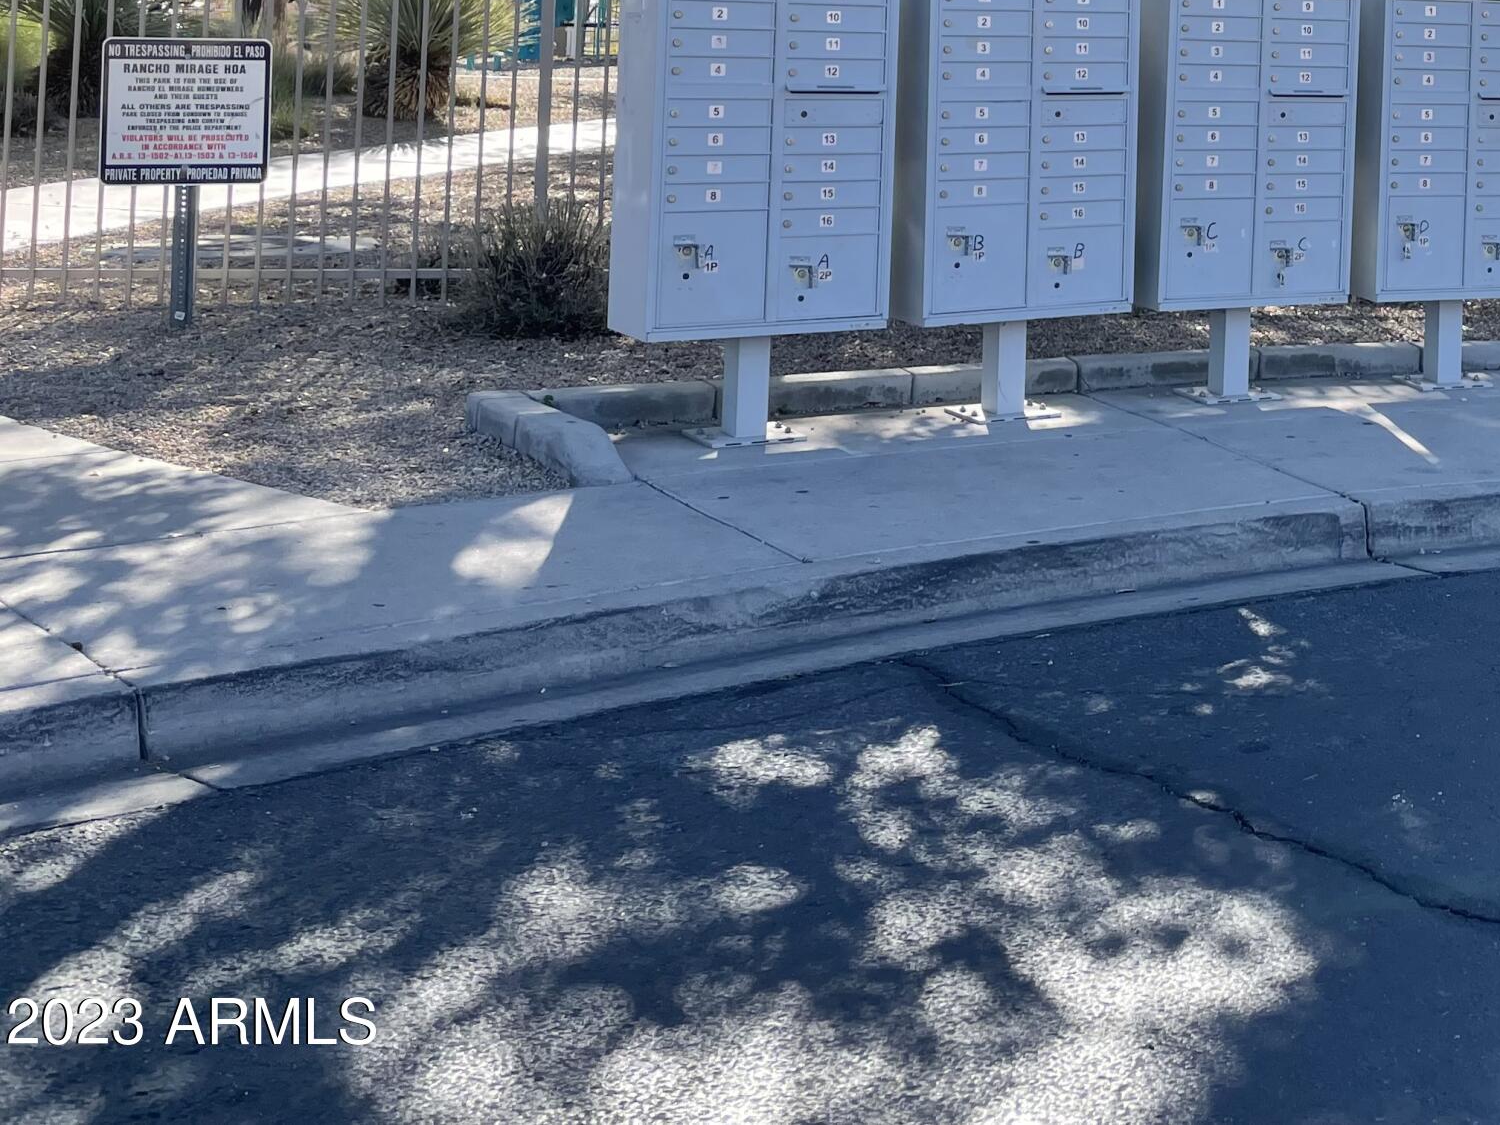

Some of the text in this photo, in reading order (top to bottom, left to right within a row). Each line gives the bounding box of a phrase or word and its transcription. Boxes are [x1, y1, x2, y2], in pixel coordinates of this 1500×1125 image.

[717, 9, 724, 19] 2
[828, 12, 840, 22] 10
[981, 17, 988, 27] 2
[1078, 19, 1088, 28] 10
[1303, 26, 1312, 35] 10
[828, 40, 839, 49] 11
[981, 43, 987, 53] 3
[1078, 44, 1087, 52] 11
[109, 44, 264, 58] NO TRESPASSING PROHIBIDO EL PASO
[124, 64, 246, 74] RANCHO MIRAGE HOA
[714, 65, 721, 74] 4
[826, 67, 838, 76] 12
[980, 69, 986, 78] 4
[1077, 69, 1087, 79] 12
[1301, 73, 1310, 82] 12
[713, 107, 720, 116] 5
[979, 108, 985, 117] 5
[712, 134, 719, 144] 6
[824, 134, 835, 144] 13
[978, 134, 985, 144] 6
[1076, 132, 1086, 141] 13
[1299, 132, 1308, 141] 13
[823, 162, 834, 171] 14
[978, 160, 984, 169] 7
[1075, 158, 1085, 166] 14
[105, 168, 262, 180] PRIVATE PROPERTY PROPIEDAD PRIVADA
[1074, 183, 1084, 192] 15
[1297, 180, 1306, 188] 15
[823, 189, 834, 198] 15
[977, 186, 983, 196] 8
[710, 191, 717, 201] 8
[1074, 209, 1084, 218] 16
[821, 216, 833, 226] 16
[1207, 222, 1218, 239] C
[1420, 220, 1429, 234] D
[973, 235, 984, 251] B
[1298, 237, 1307, 251] C
[704, 245, 714, 260] A
[1074, 243, 1085, 259] B
[975, 252, 984, 260] 1P
[818, 254, 829, 268] A
[705, 263, 718, 271] 1P
[819, 271, 832, 280] 2P
